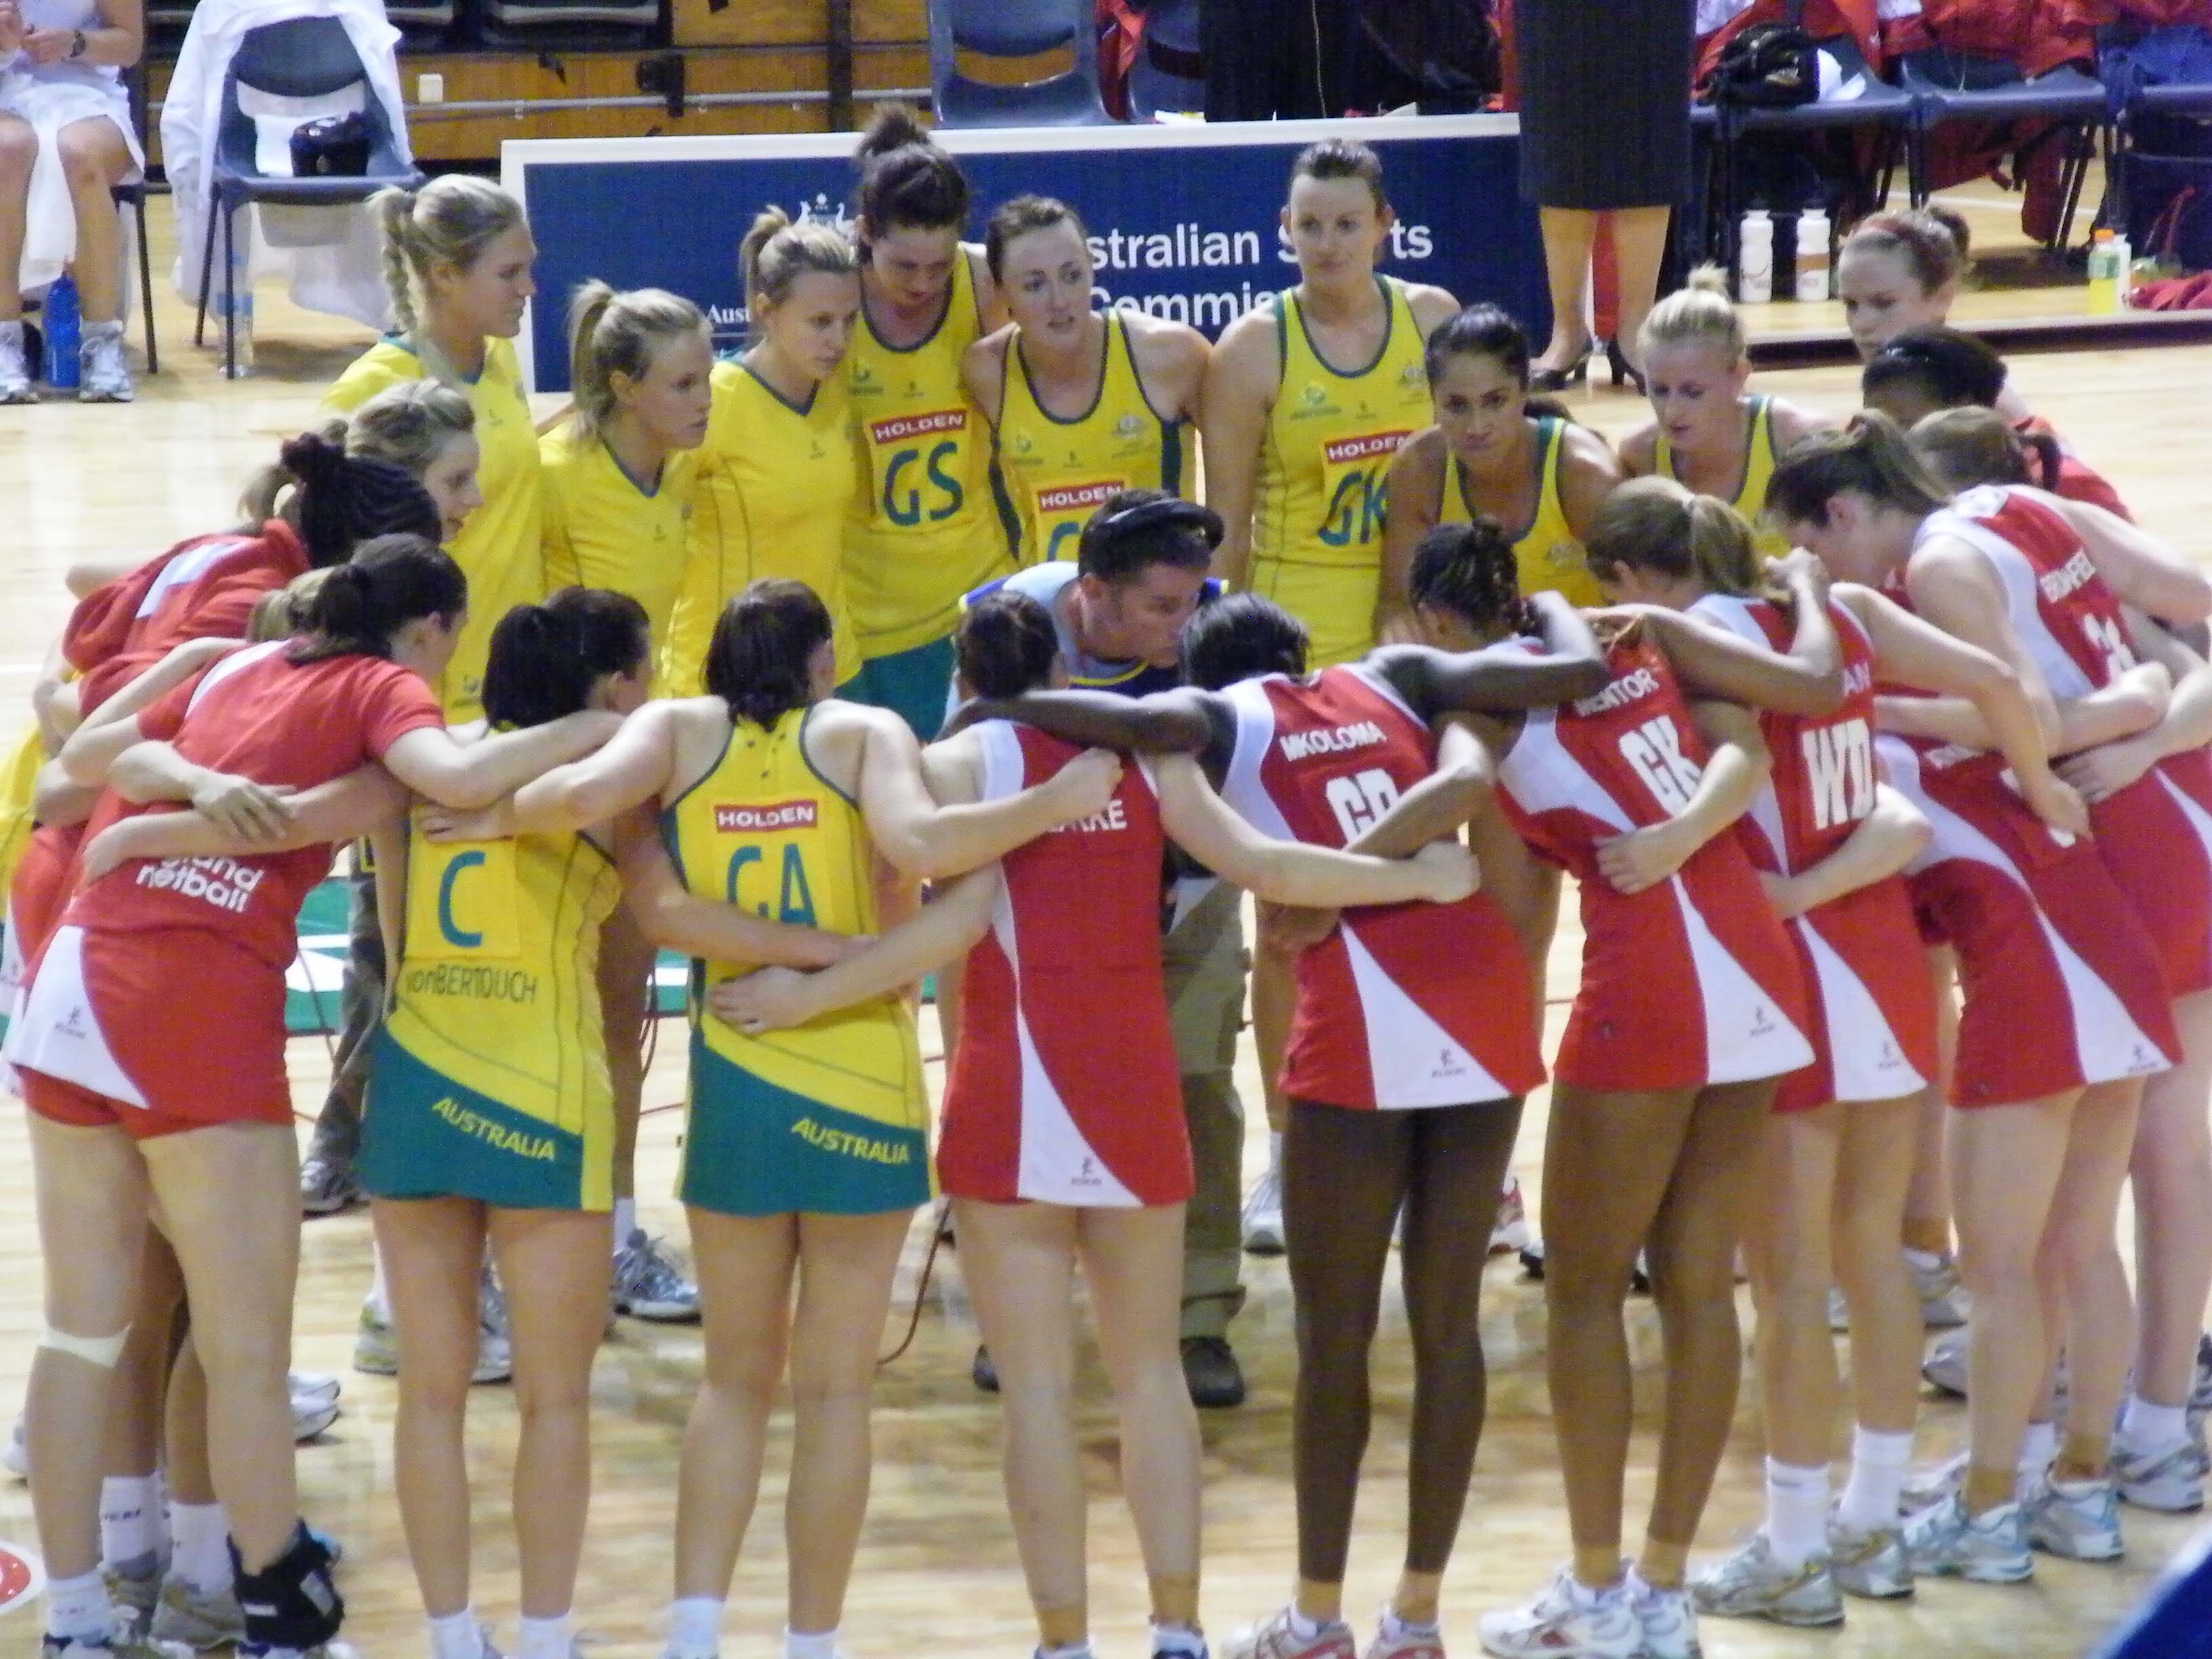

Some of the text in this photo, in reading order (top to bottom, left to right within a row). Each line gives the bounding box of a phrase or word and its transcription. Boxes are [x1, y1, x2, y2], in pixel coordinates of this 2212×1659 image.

[1084, 222, 1259, 270] stralian
[876, 414, 962, 440] HOLDEN
[883, 441, 964, 526] GS
[1801, 716, 1877, 831] WD
[718, 806, 814, 827] HOLDEN
[437, 850, 485, 947] C
[432, 1097, 554, 1162] AUSTRALIA
[791, 1118, 909, 1164] AUSTRALIA
